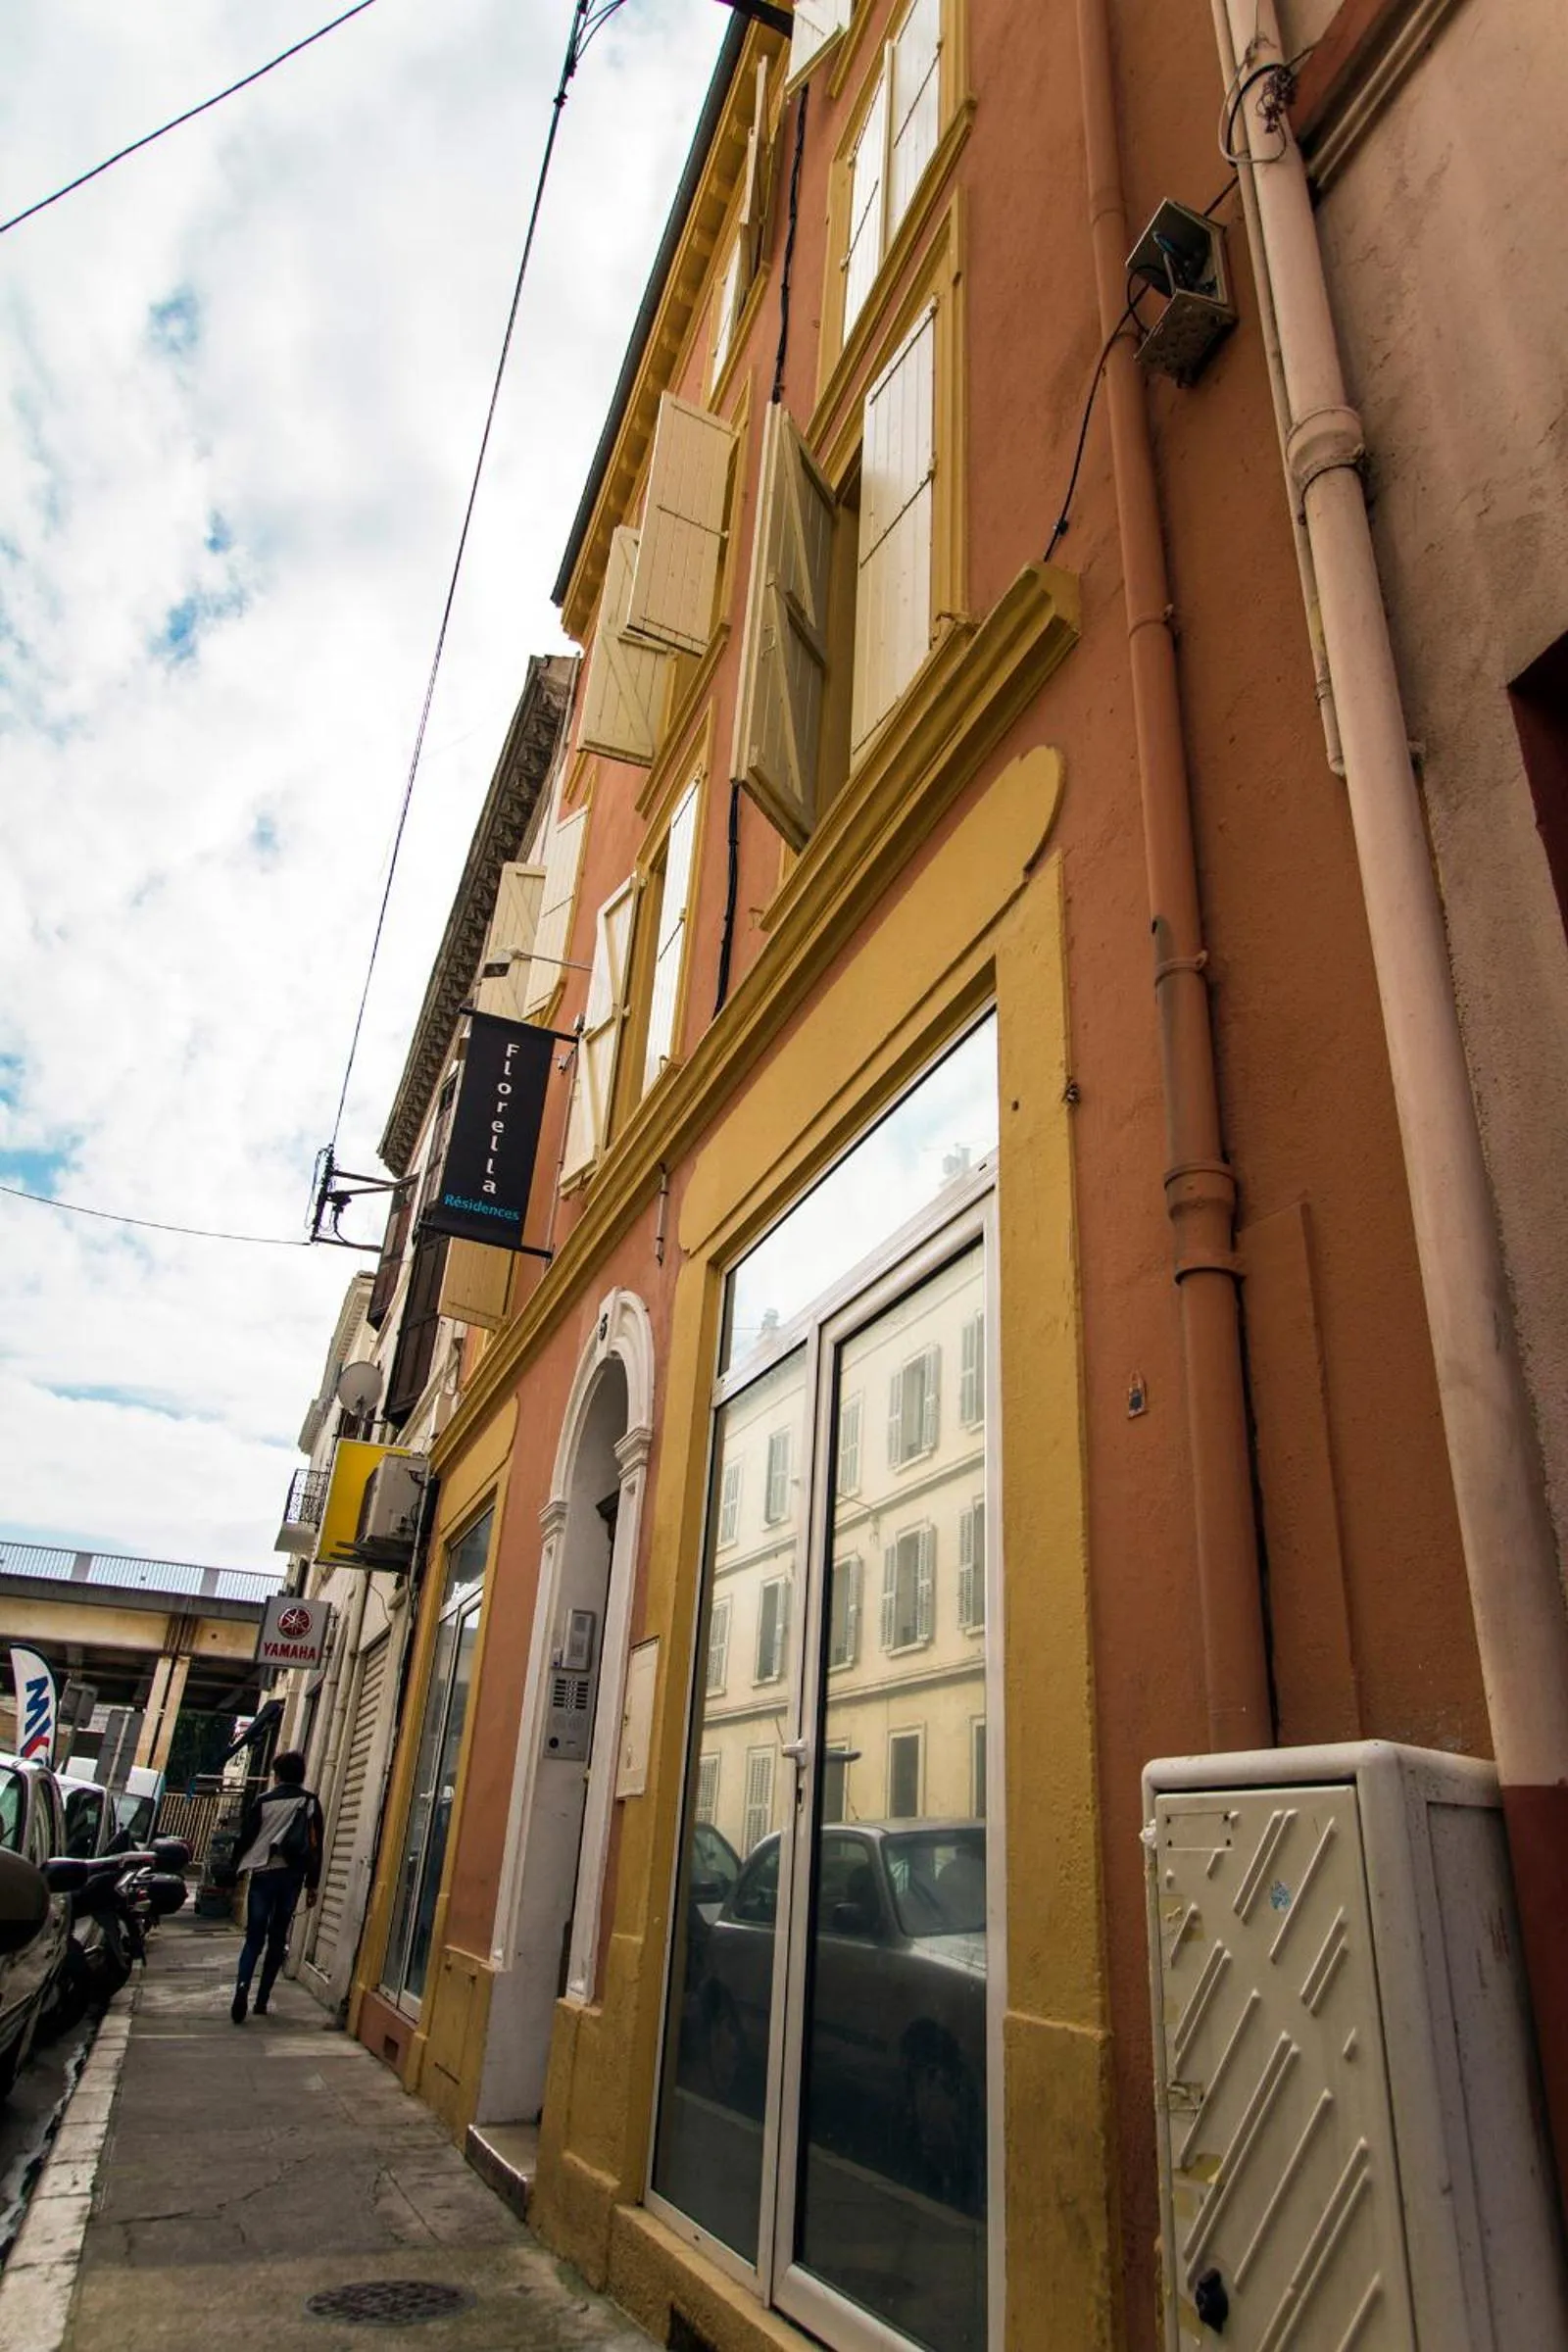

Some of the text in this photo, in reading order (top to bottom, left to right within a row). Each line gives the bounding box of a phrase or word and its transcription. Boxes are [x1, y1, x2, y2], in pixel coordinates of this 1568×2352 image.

[482, 1043, 519, 1194] Florella
[444, 1193, 519, 1220] Résidences
[264, 1642, 316, 1660] YAMAHA
